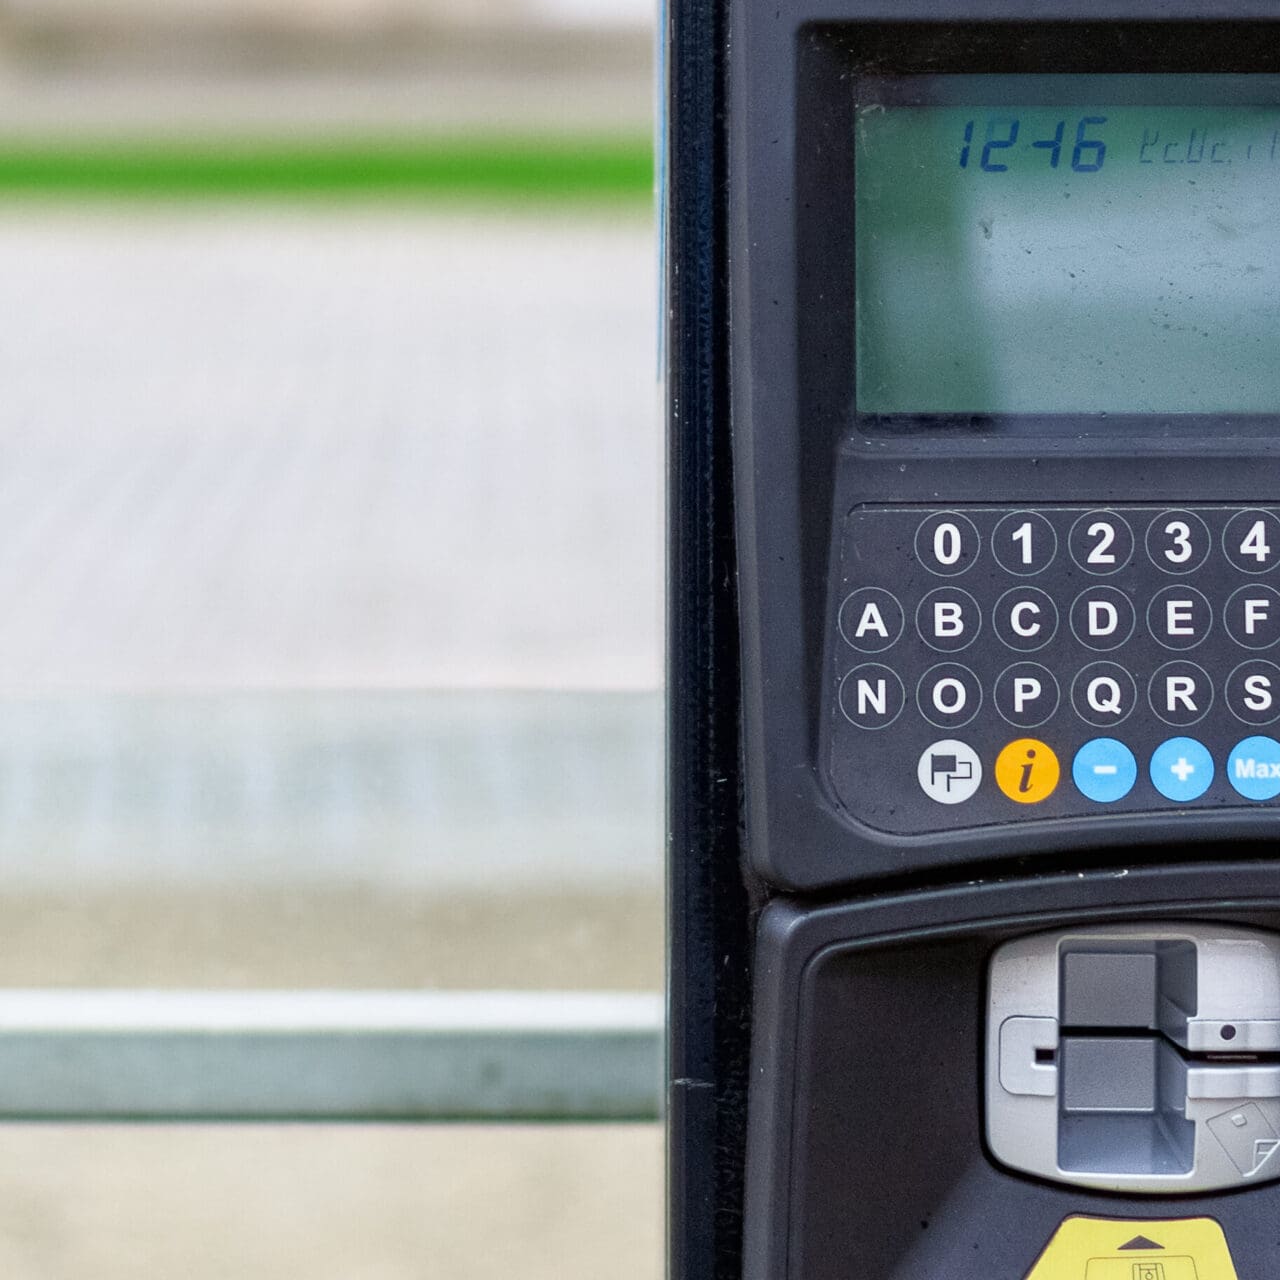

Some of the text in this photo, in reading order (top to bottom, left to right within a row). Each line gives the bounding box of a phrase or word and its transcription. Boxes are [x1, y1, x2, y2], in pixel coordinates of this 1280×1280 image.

[934, 523, 961, 564] 0
[1013, 523, 1032, 563] 1
[1088, 523, 1115, 563] 2
[1165, 522, 1192, 562] 3
[1240, 521, 1270, 561] 4
[855, 603, 888, 637] A
[935, 603, 963, 636] B
[1011, 602, 1040, 636] C
[1089, 601, 1117, 635] D
[1167, 601, 1194, 635] E
[1245, 600, 1269, 634] F
[858, 680, 885, 714] N
[933, 678, 966, 713] O
[1014, 678, 1041, 712] P
[1087, 677, 1121, 714] Q
[1167, 677, 1197, 711] R
[1244, 675, 1272, 710] S
[1019, 749, 1036, 792] i
